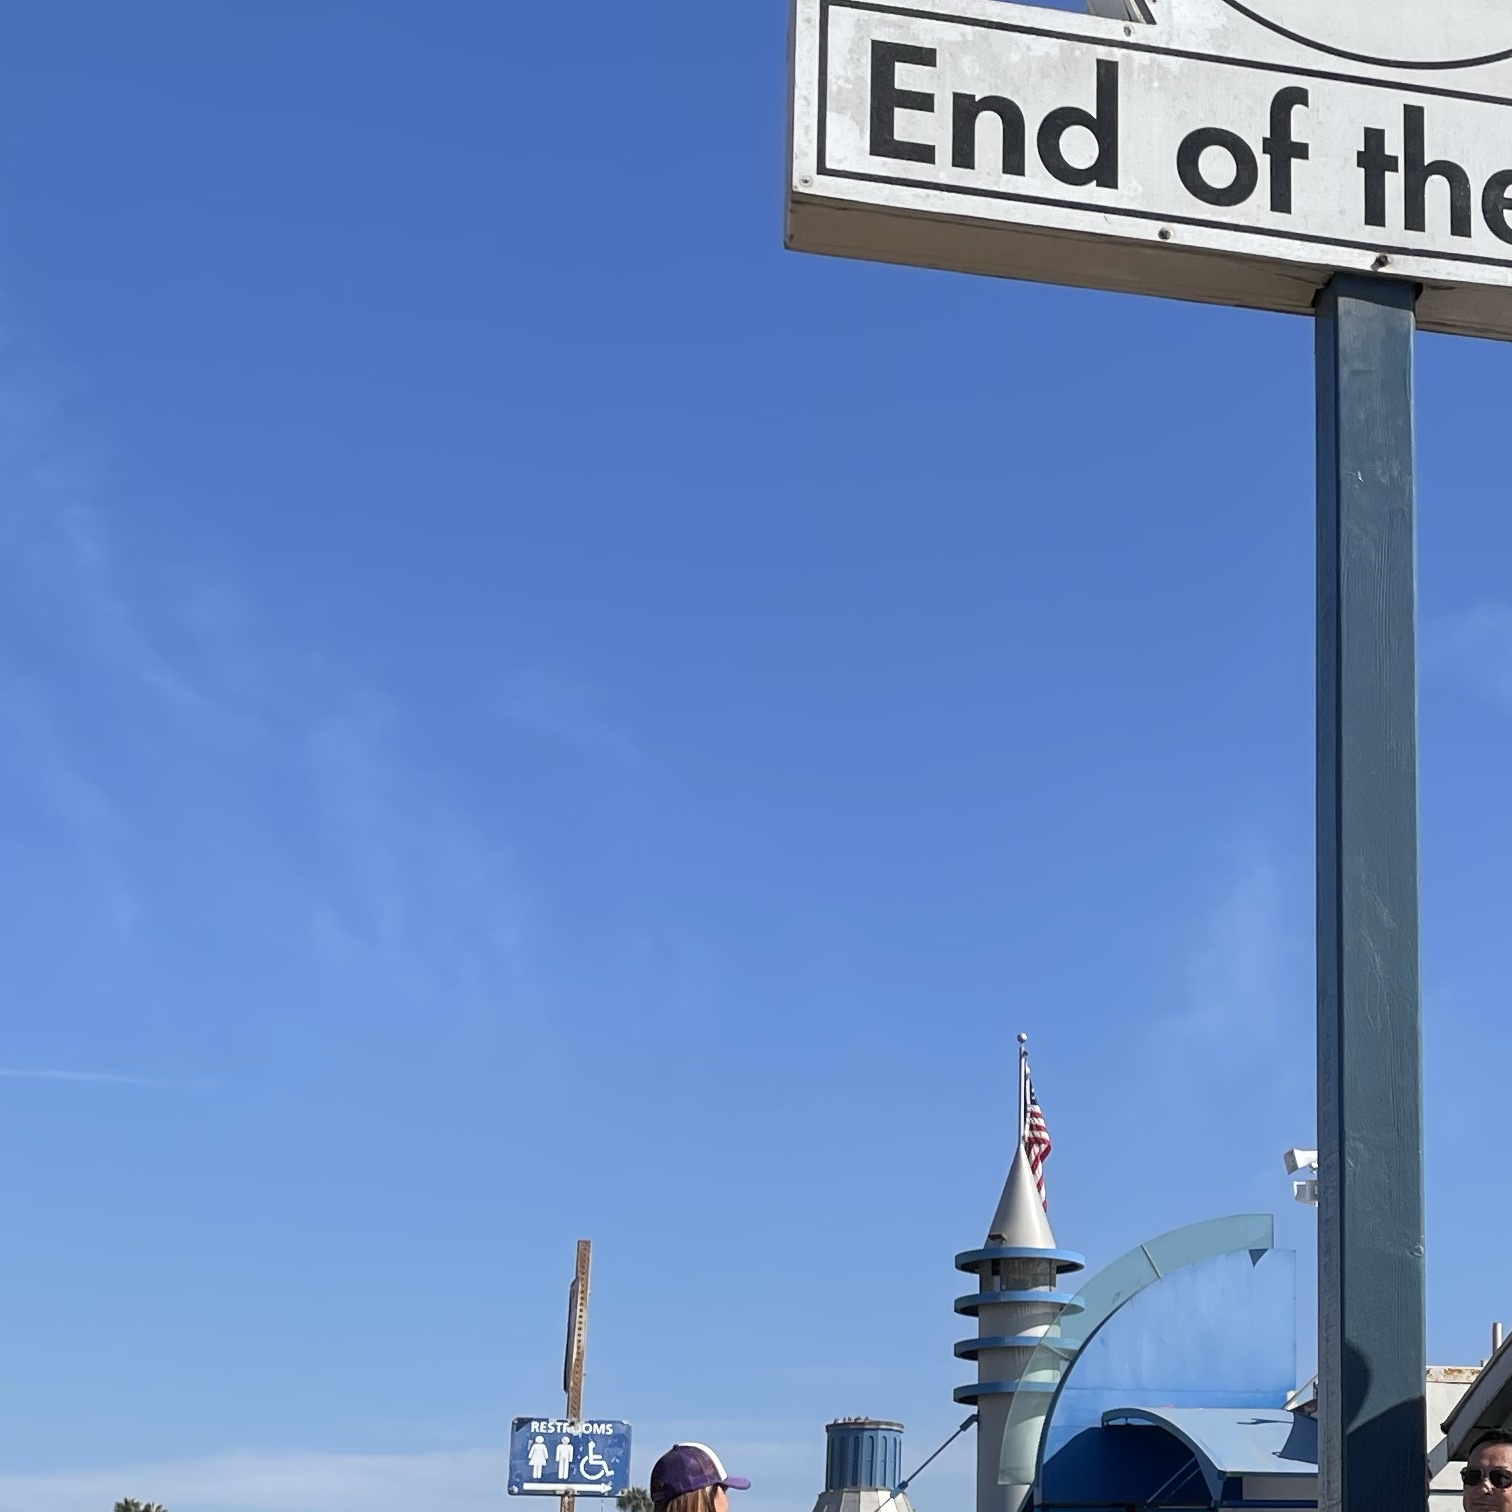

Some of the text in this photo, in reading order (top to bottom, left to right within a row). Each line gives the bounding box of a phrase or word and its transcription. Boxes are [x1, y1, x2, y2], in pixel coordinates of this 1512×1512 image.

[868, 39, 1119, 190] End
[1175, 86, 1309, 214] of
[531, 1421, 614, 1435] RESTROMS
